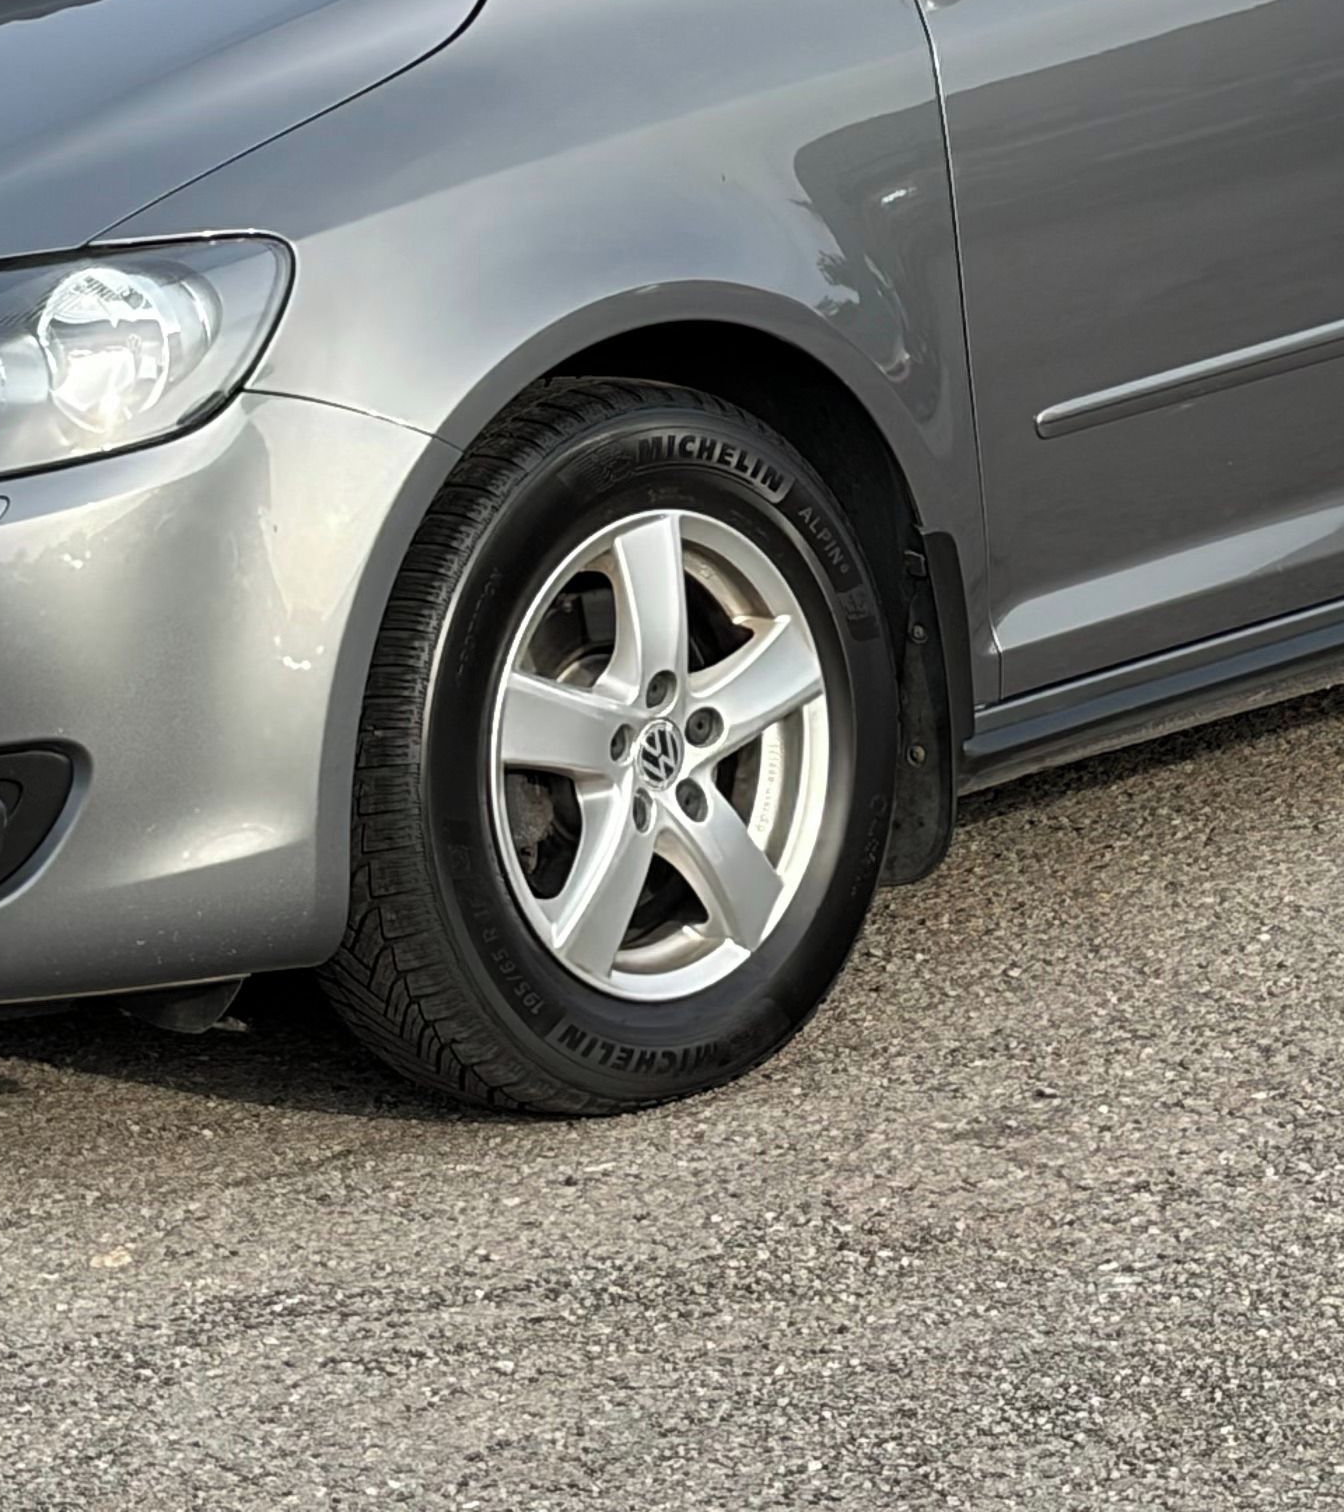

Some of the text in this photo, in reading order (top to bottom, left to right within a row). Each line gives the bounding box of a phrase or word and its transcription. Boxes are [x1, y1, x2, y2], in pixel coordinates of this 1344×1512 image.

[635, 433, 786, 494] MICHELIN
[798, 505, 845, 565] ALPIN
[490, 950, 545, 1016] 195/65
[558, 1023, 718, 1077] MICHELIN
